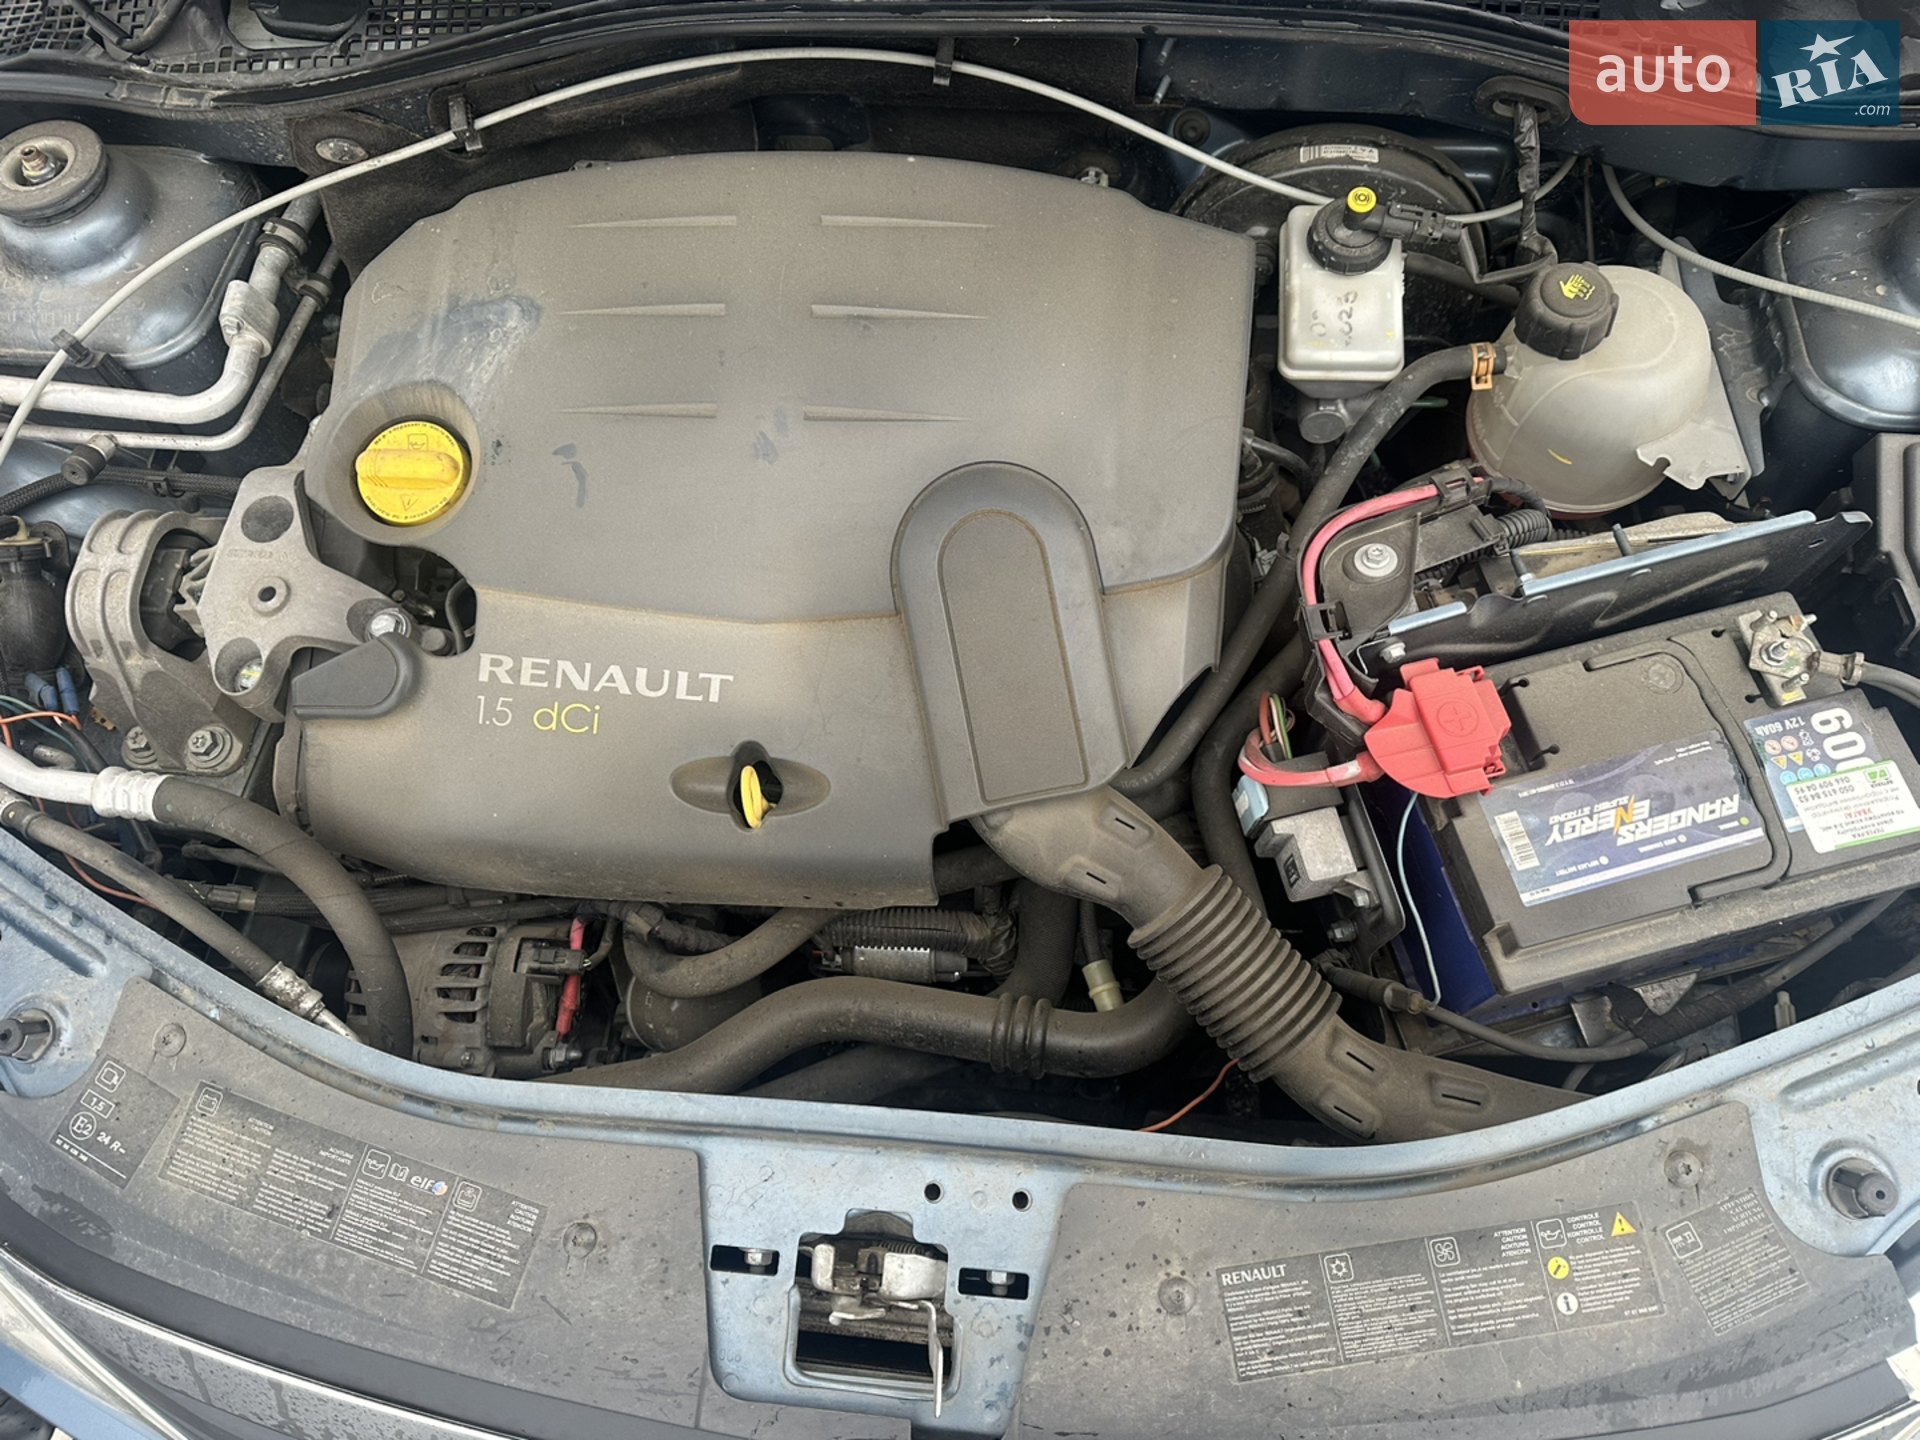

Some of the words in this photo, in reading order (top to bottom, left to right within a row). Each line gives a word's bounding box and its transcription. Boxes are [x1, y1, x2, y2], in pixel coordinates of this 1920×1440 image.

[478, 653, 734, 703] RENAULT
[477, 695, 513, 726] 1.5
[533, 702, 601, 735] dCi
[1755, 721, 1783, 737] 60Ah
[1784, 716, 1805, 730] 12V
[1593, 796, 1630, 812] SUPER
[1545, 796, 1651, 847] ENERGY
[1616, 793, 1740, 847] RANGERS
[96, 1131, 112, 1145] 24
[410, 1175, 435, 1190] elf
[1566, 1212, 1600, 1223] CONTROLE
[1572, 1219, 1602, 1230] CONTROL
[1493, 1227, 1526, 1238] ATTENTION
[1501, 1234, 1528, 1243] CAUTION
[1566, 1227, 1604, 1239] KONTROLLE
[1501, 1241, 1530, 1250] ACHTUNG
[1575, 1235, 1606, 1245] CONTROL
[1221, 1263, 1287, 1287] RENAULT
